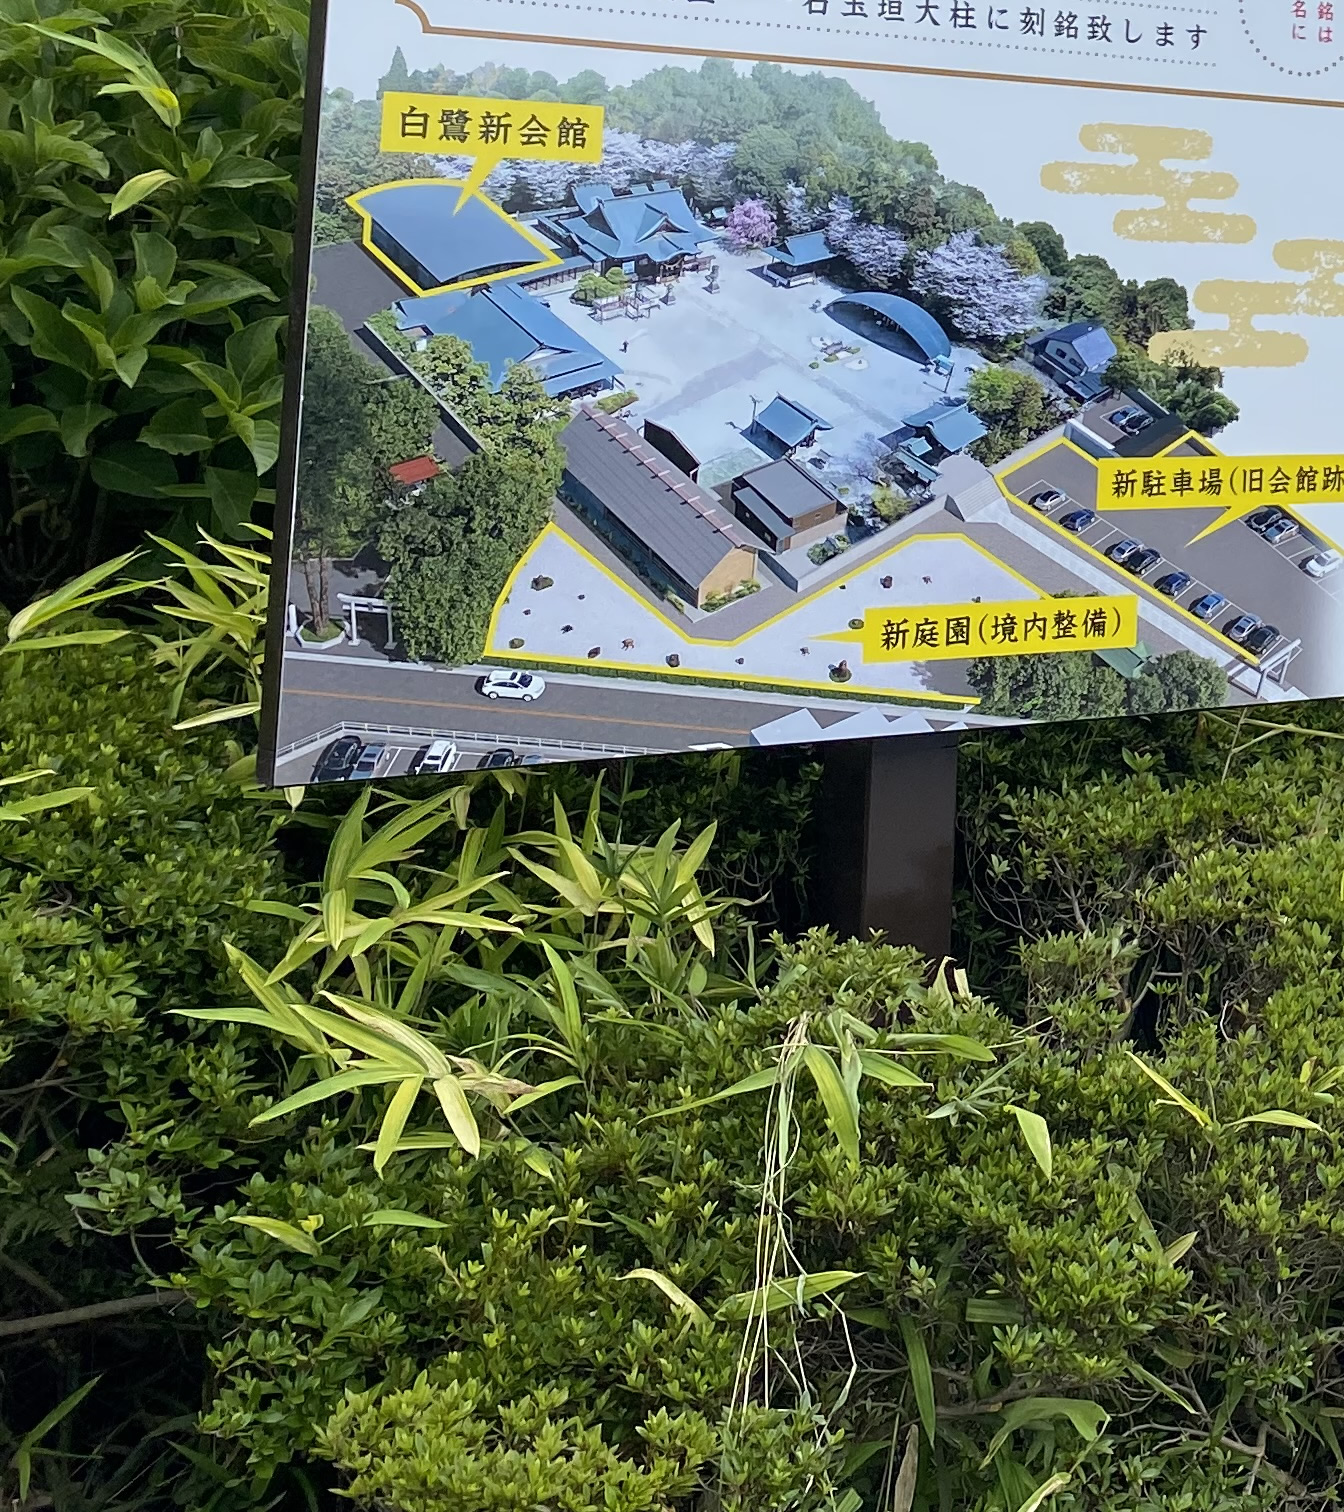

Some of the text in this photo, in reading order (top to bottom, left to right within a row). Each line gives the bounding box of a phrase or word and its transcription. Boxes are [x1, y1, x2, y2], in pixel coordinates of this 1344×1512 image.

[401, 106, 589, 149] 白鷺新会館
